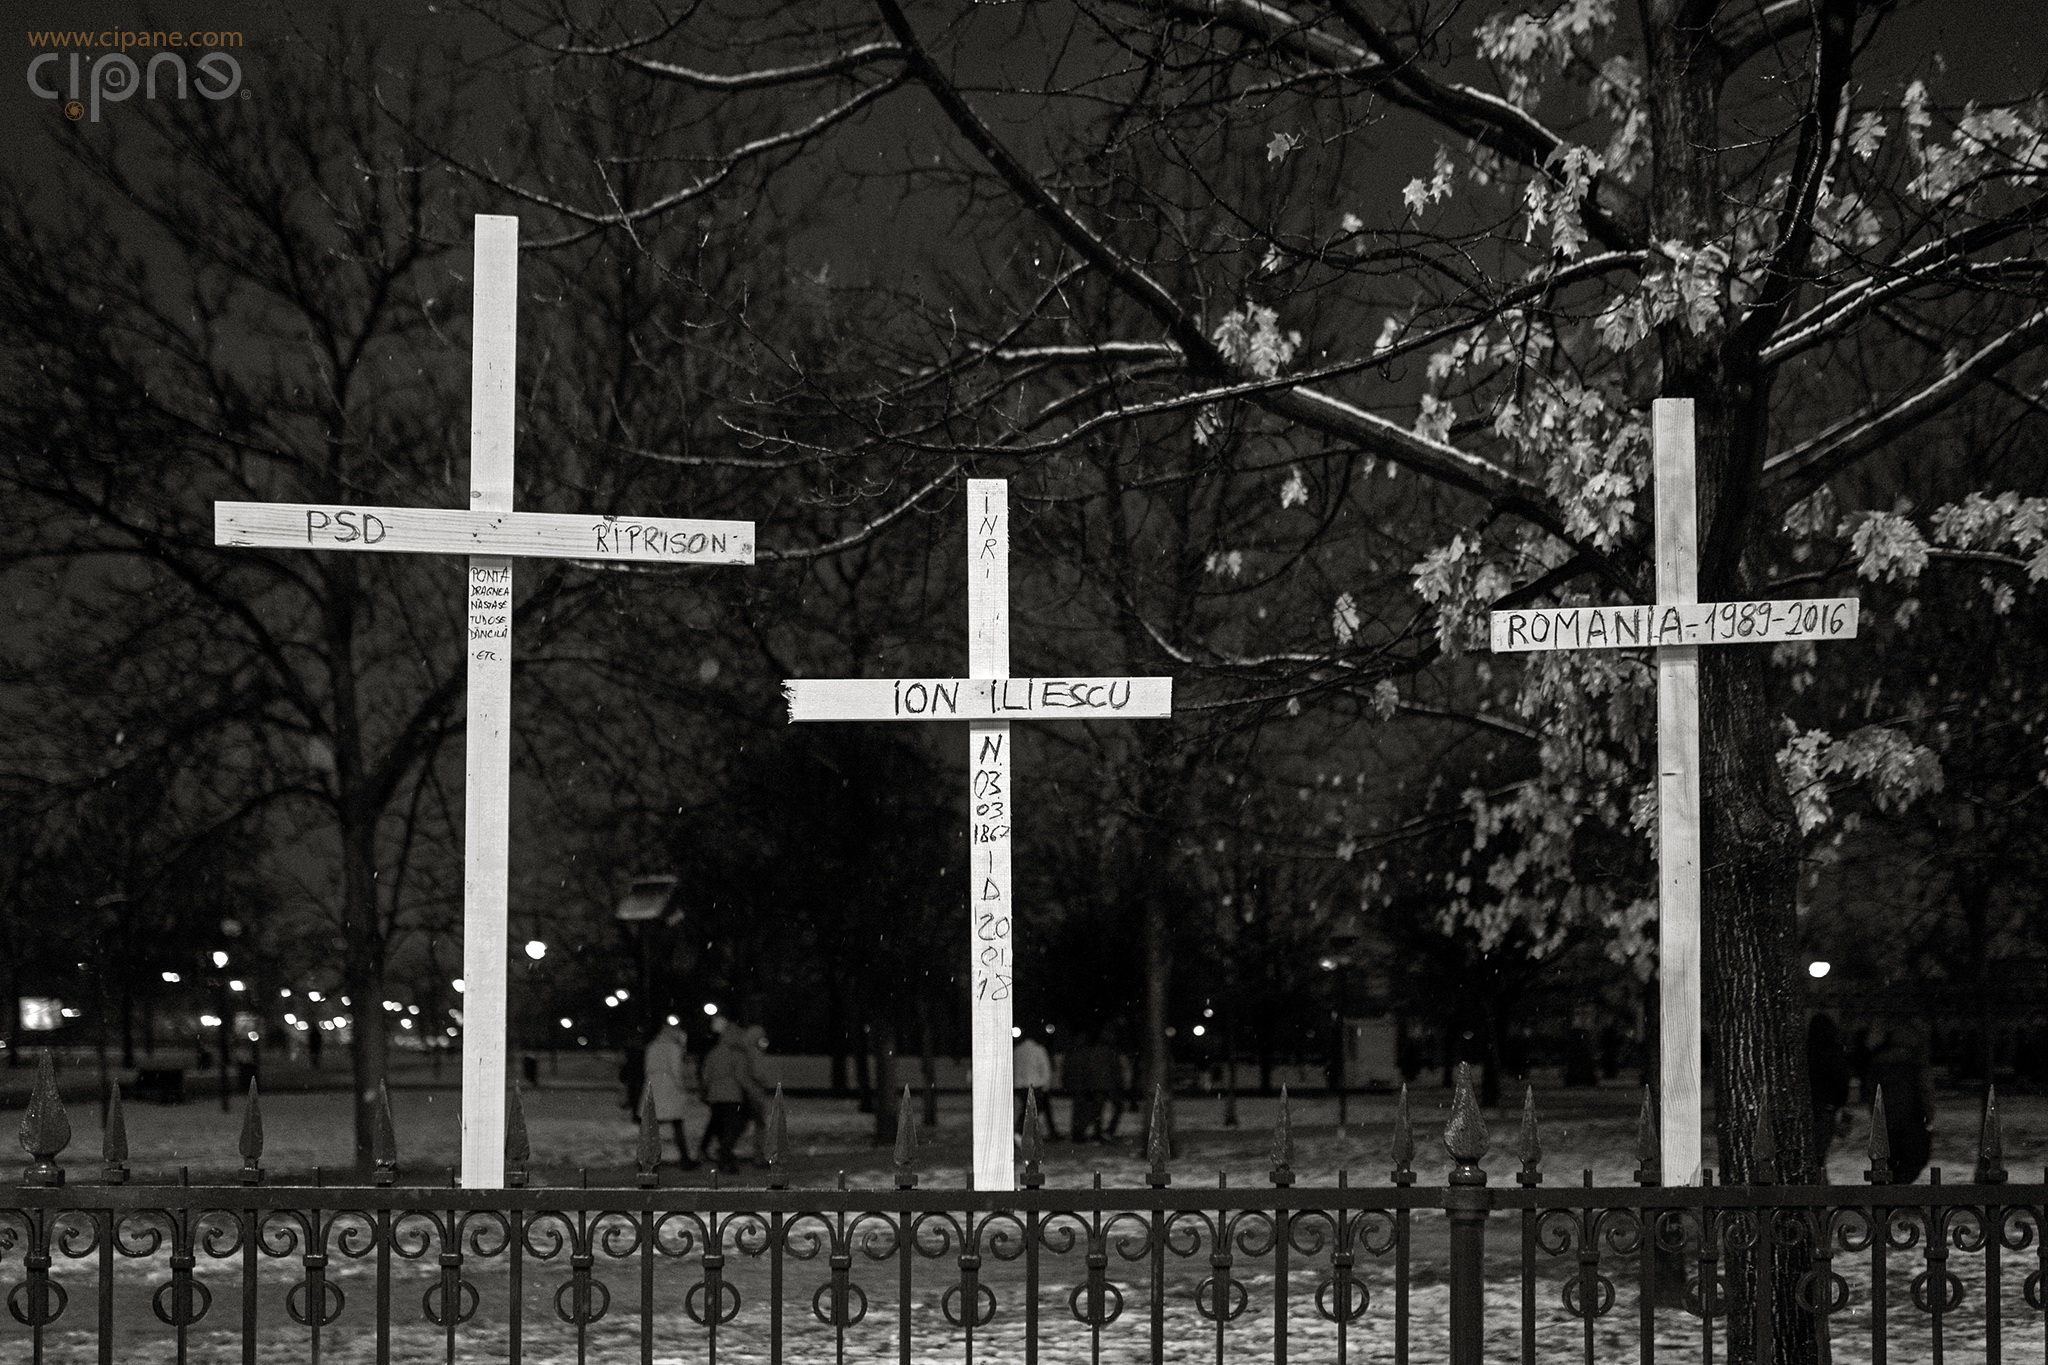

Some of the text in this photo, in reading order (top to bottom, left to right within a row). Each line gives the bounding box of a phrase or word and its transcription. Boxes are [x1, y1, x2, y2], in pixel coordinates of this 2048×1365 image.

[470, 566, 510, 583] PONTA
[469, 614, 506, 625] TUDOSE
[894, 680, 1131, 715] ION ILIESCU
